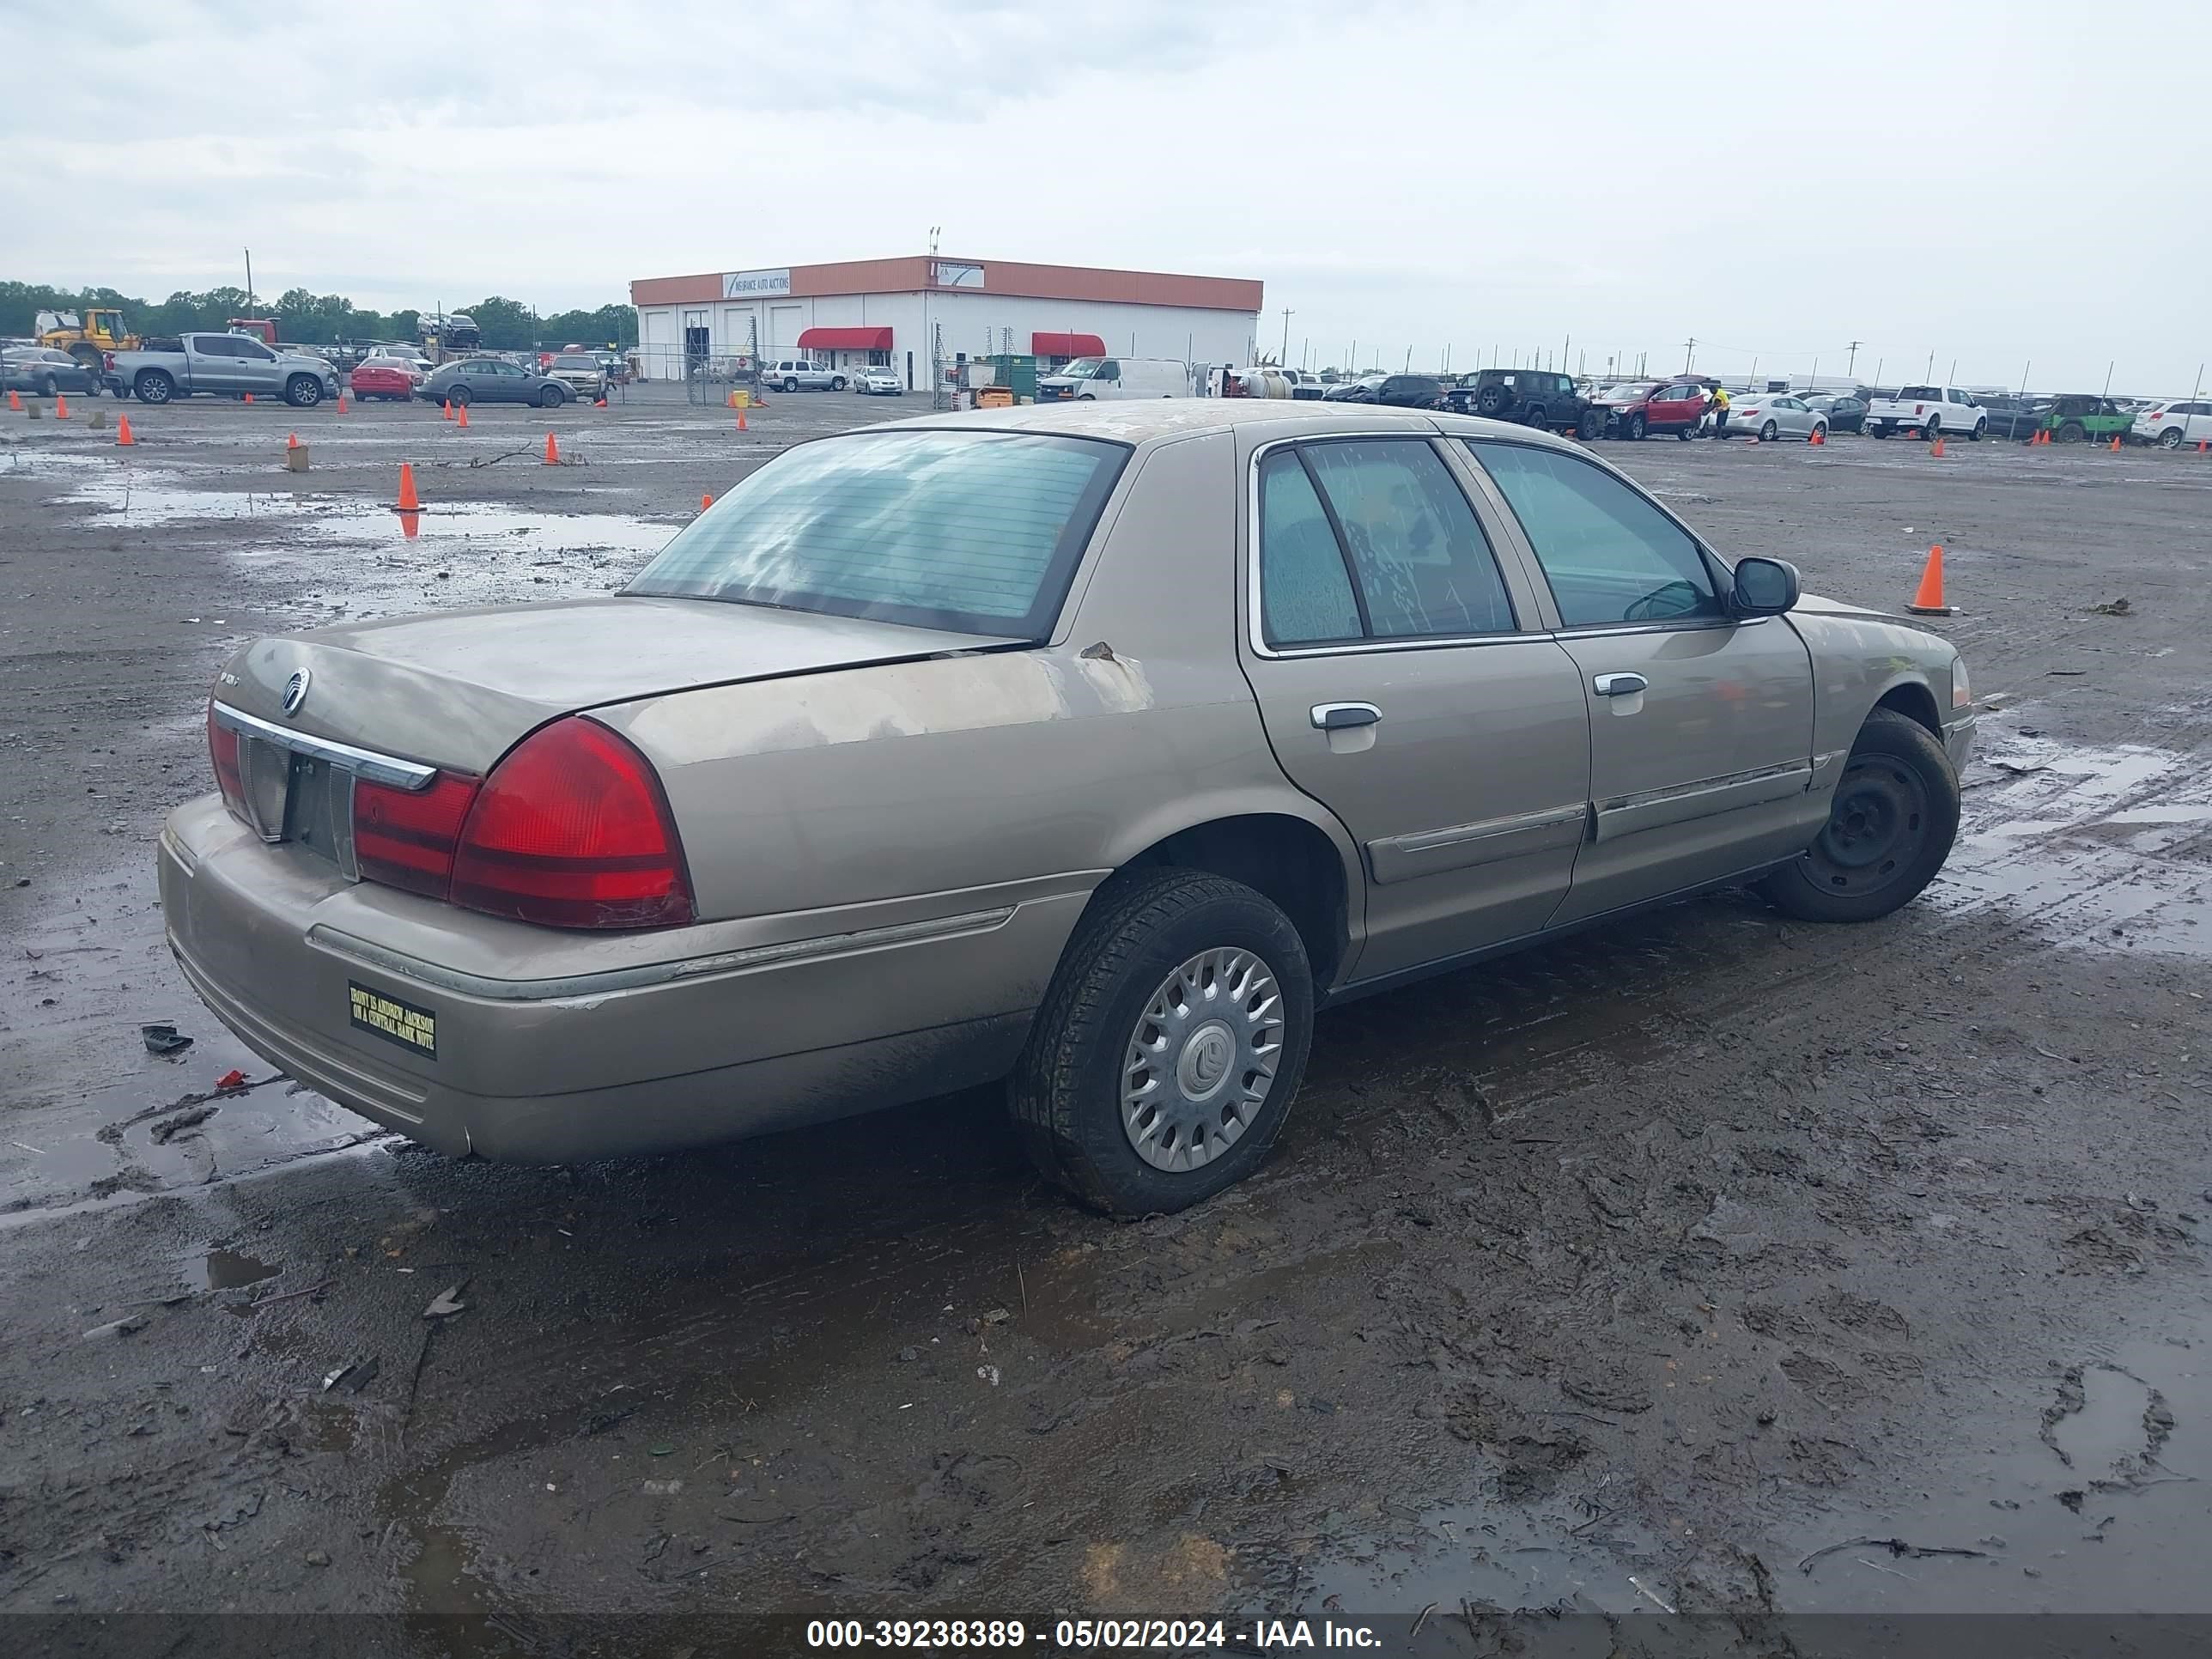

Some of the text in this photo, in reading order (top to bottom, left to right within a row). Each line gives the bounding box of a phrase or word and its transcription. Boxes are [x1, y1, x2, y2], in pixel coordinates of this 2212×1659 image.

[350, 987, 434, 1034] IRONY IS ANDREW JACKSON
[353, 1003, 434, 1051] ON A CENTRAL BANK NOTE
